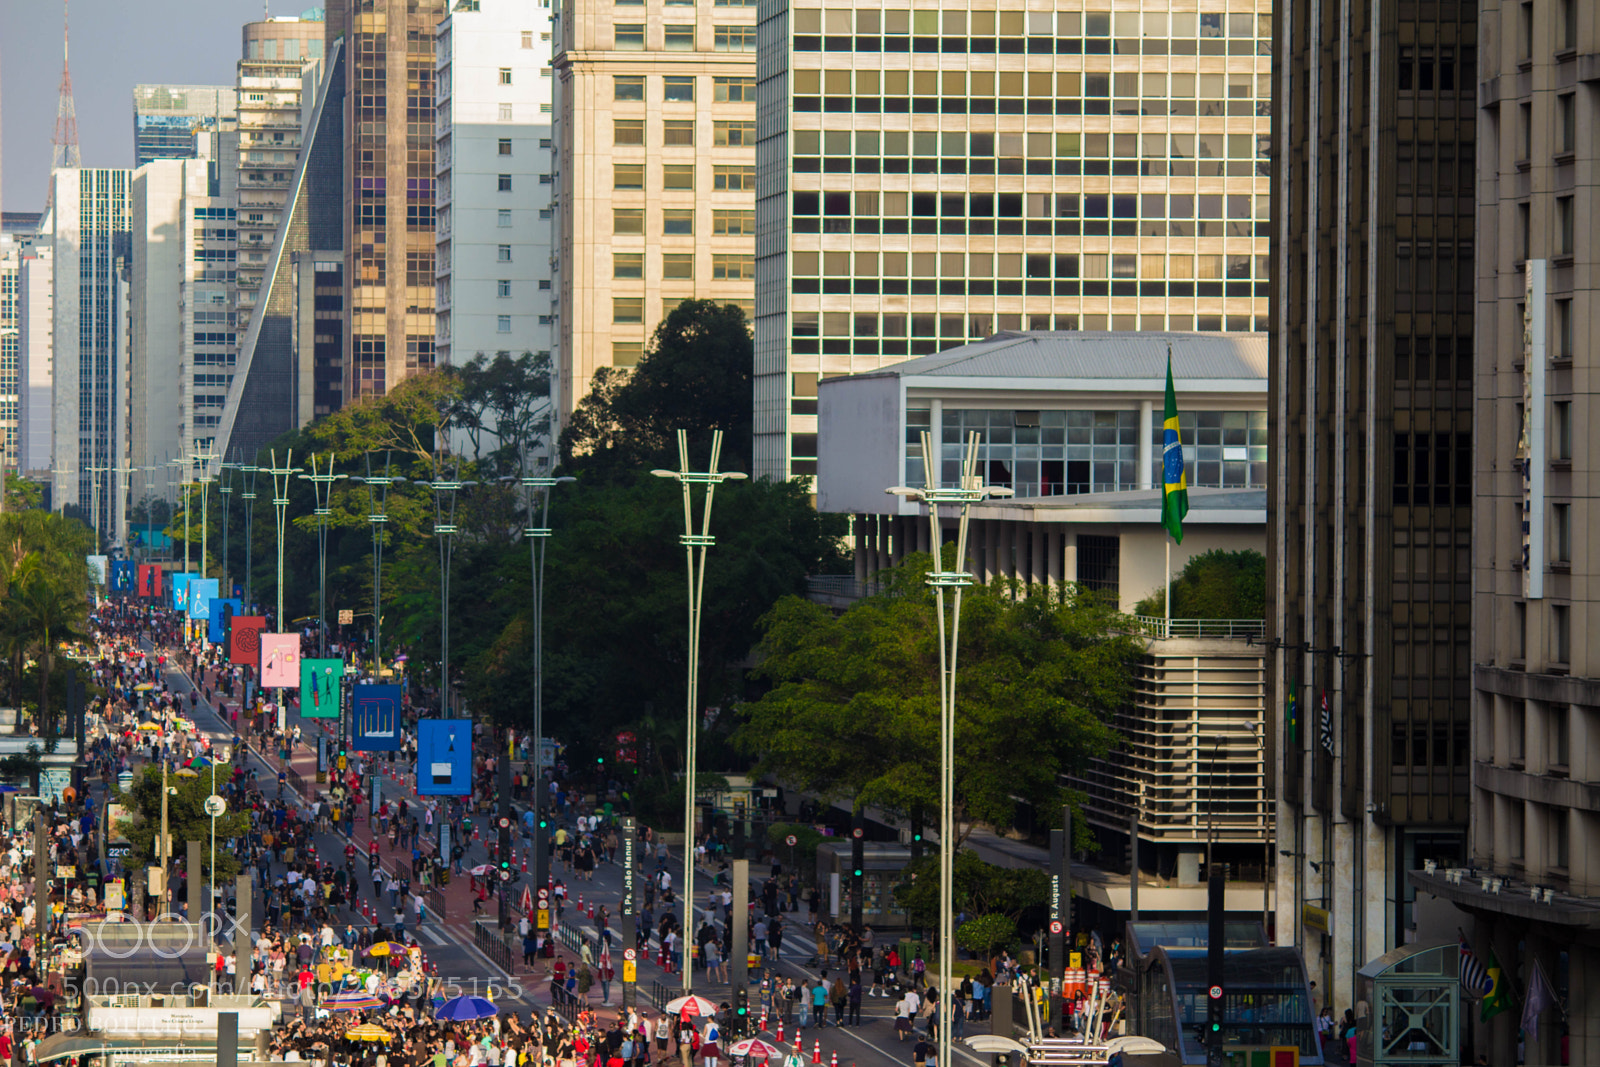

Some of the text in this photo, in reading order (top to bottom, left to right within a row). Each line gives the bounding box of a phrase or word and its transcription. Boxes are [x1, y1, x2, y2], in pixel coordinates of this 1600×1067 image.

[624, 838, 633, 869] Manuel
[624, 870, 633, 891] João
[1051, 874, 1060, 919] R. Augusta
[624, 906, 633, 915] R.
